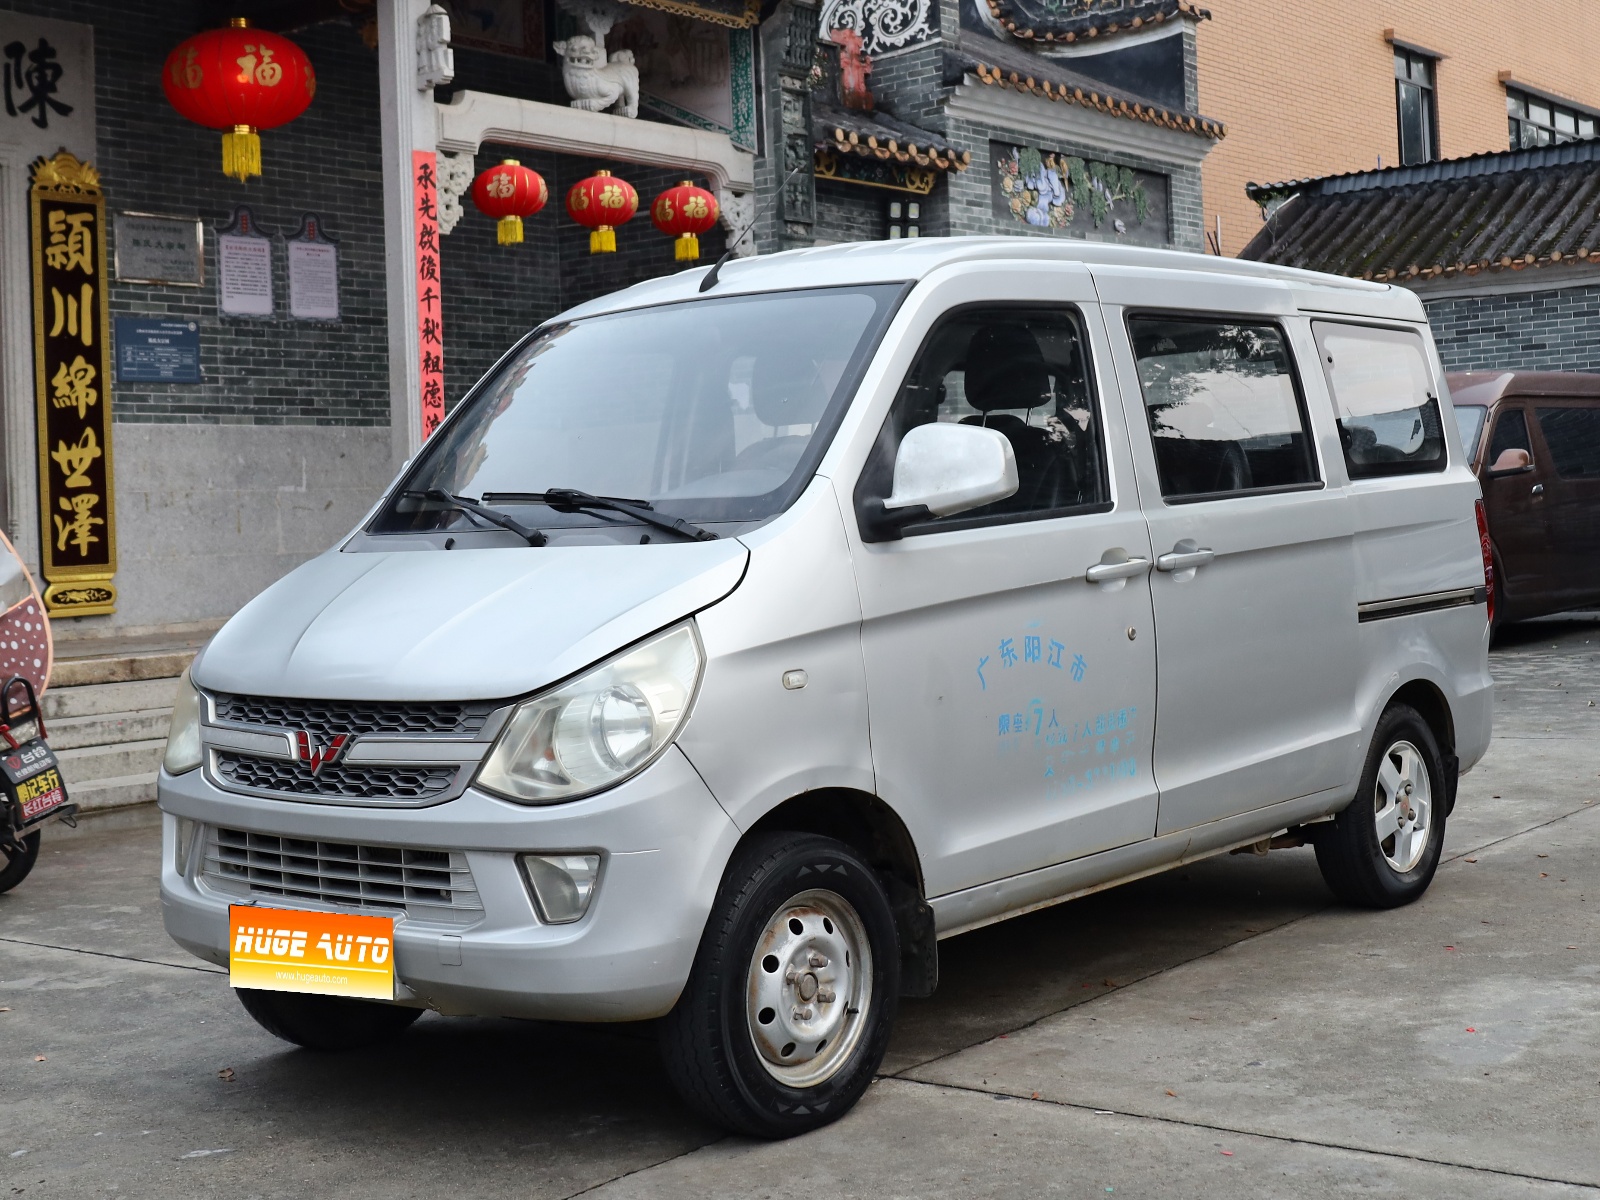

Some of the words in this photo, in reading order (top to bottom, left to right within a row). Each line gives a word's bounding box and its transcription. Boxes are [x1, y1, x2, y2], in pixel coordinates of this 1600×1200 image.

[236, 44, 283, 87] 福
[4, 38, 74, 129] 陳
[486, 173, 515, 198] 福
[599, 185, 625, 209] 福
[683, 196, 709, 219] 福
[977, 635, 1088, 690] 广东阳江市
